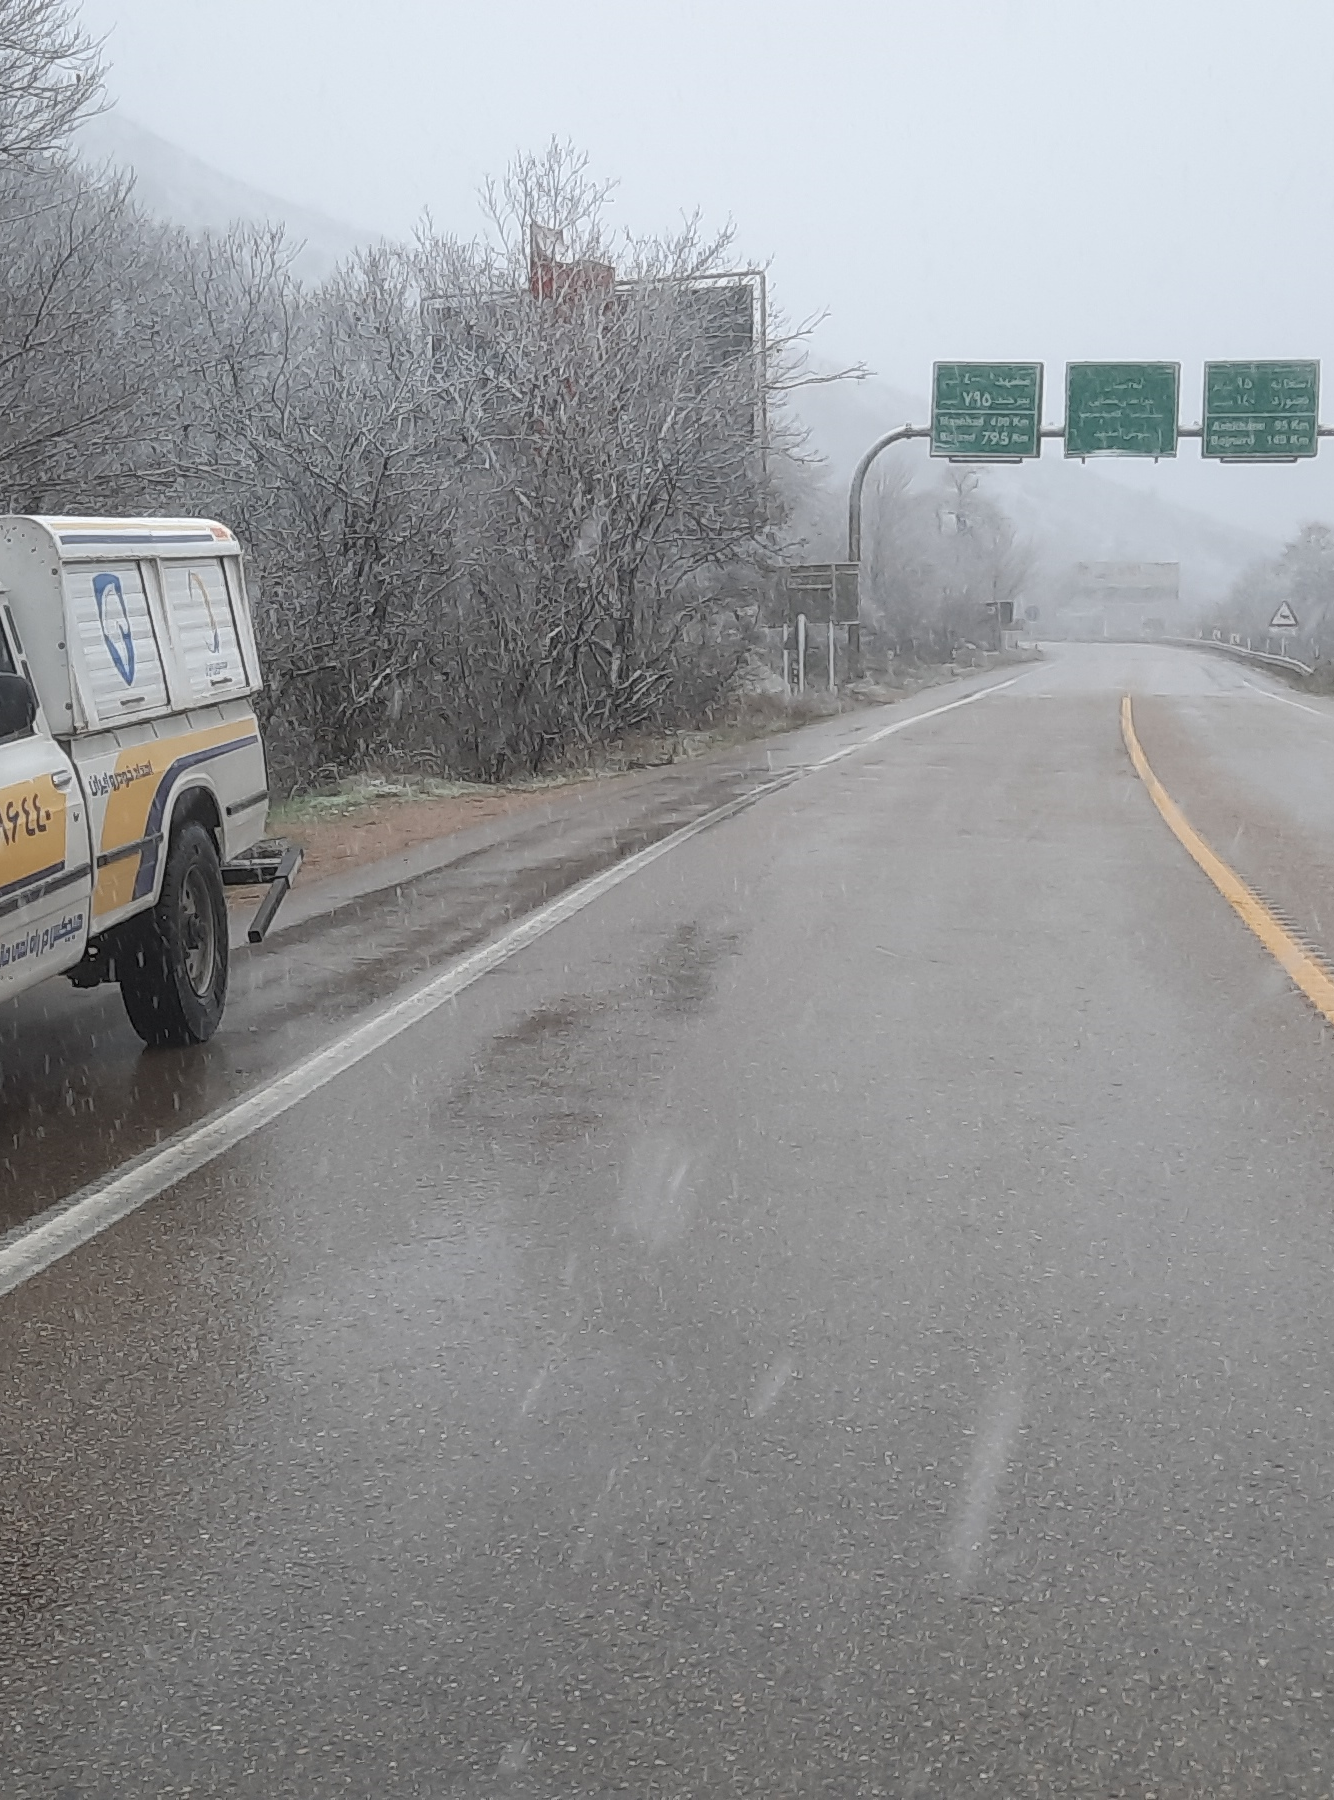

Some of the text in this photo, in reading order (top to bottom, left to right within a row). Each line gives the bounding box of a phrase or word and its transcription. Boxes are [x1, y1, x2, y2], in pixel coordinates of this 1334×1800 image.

[962, 391, 992, 407] ۷۹۵
[1290, 420, 1310, 431] Km
[981, 431, 1009, 445] 795
[1290, 435, 1310, 445] Km
